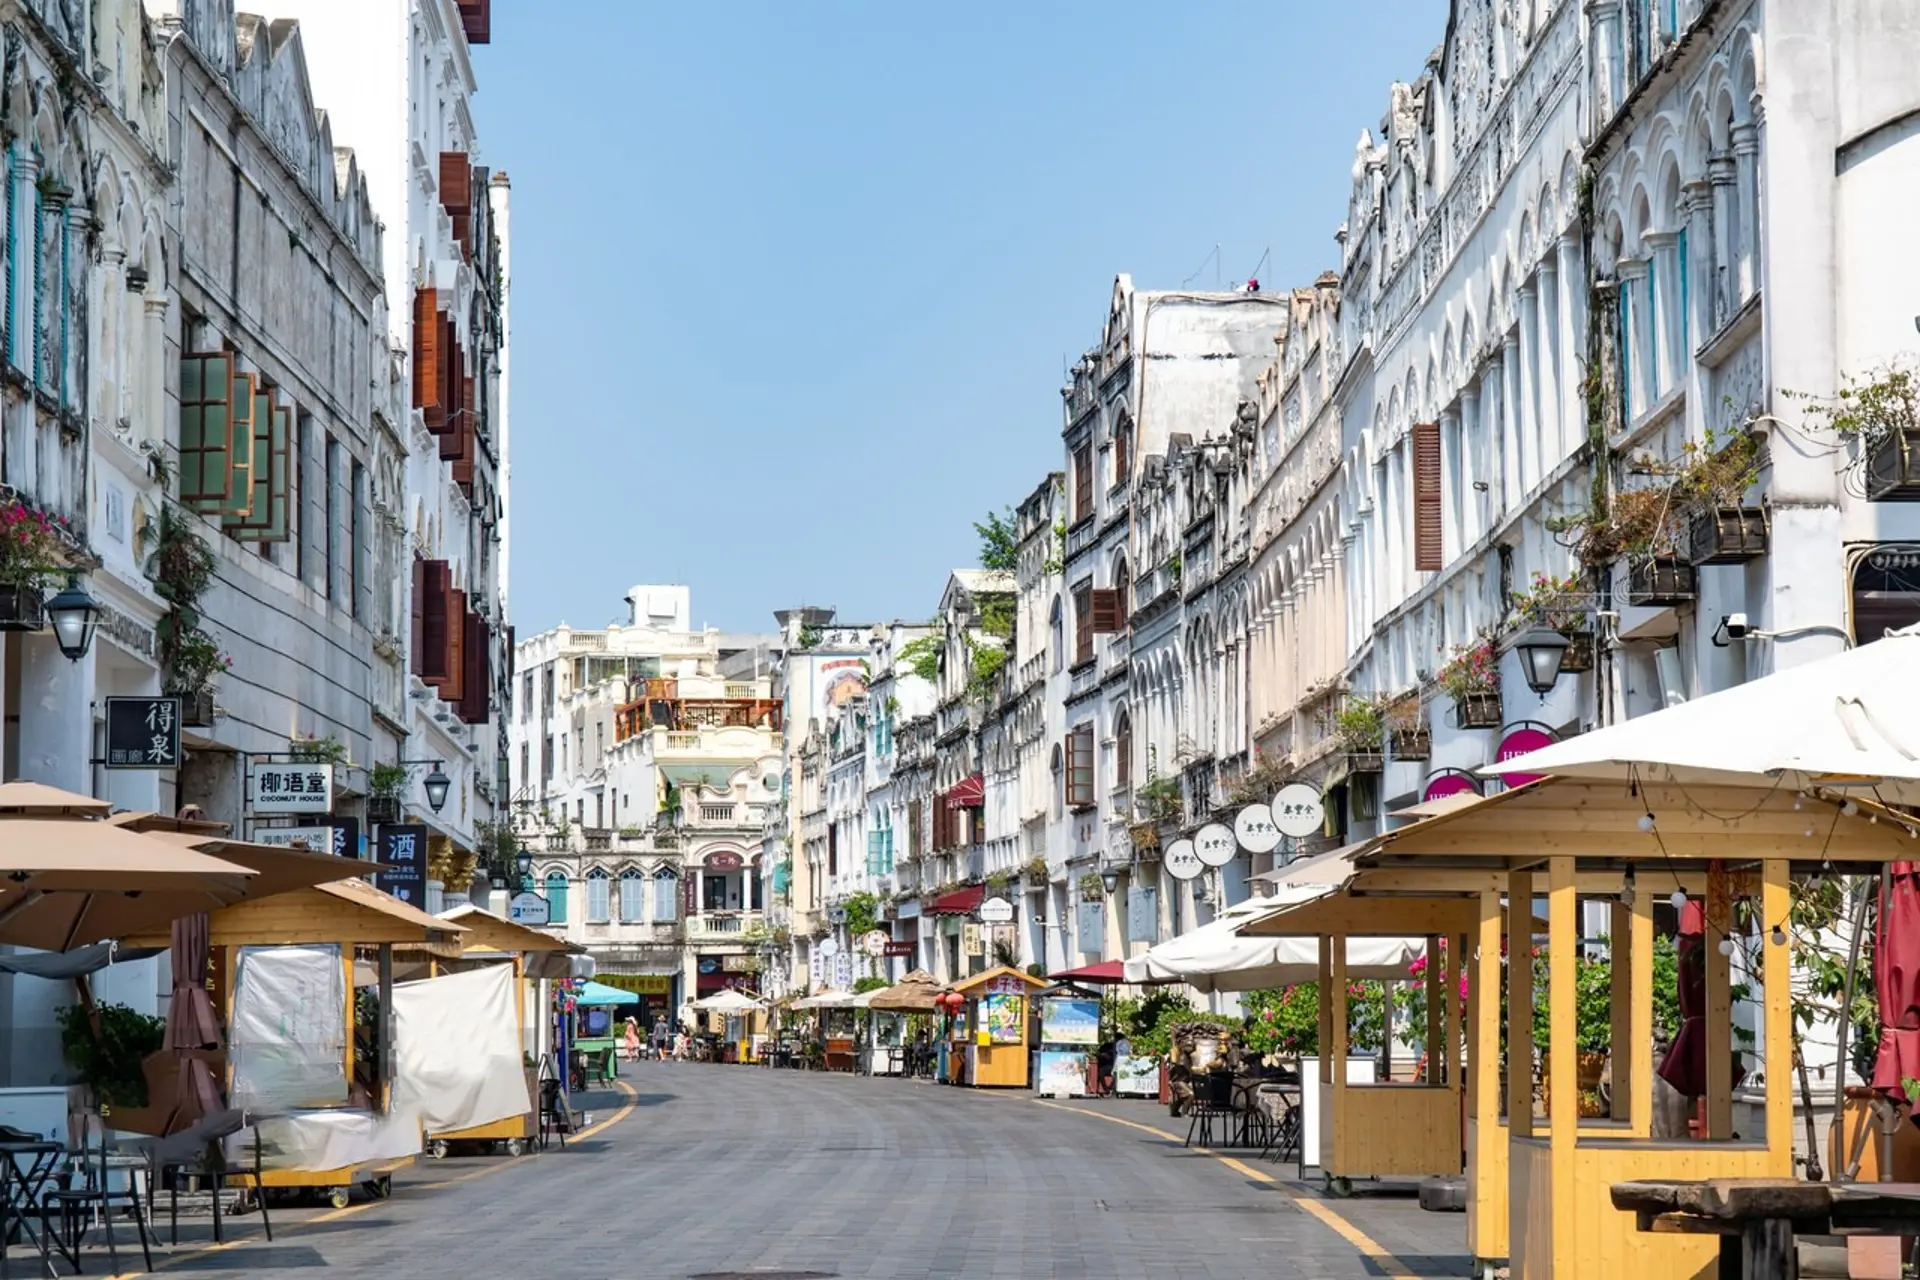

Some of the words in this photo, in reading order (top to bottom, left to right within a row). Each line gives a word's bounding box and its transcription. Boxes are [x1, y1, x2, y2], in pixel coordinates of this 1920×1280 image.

[145, 702, 174, 764] 得泉
[261, 772, 325, 793] 椰语堂
[388, 833, 417, 860] 酒
